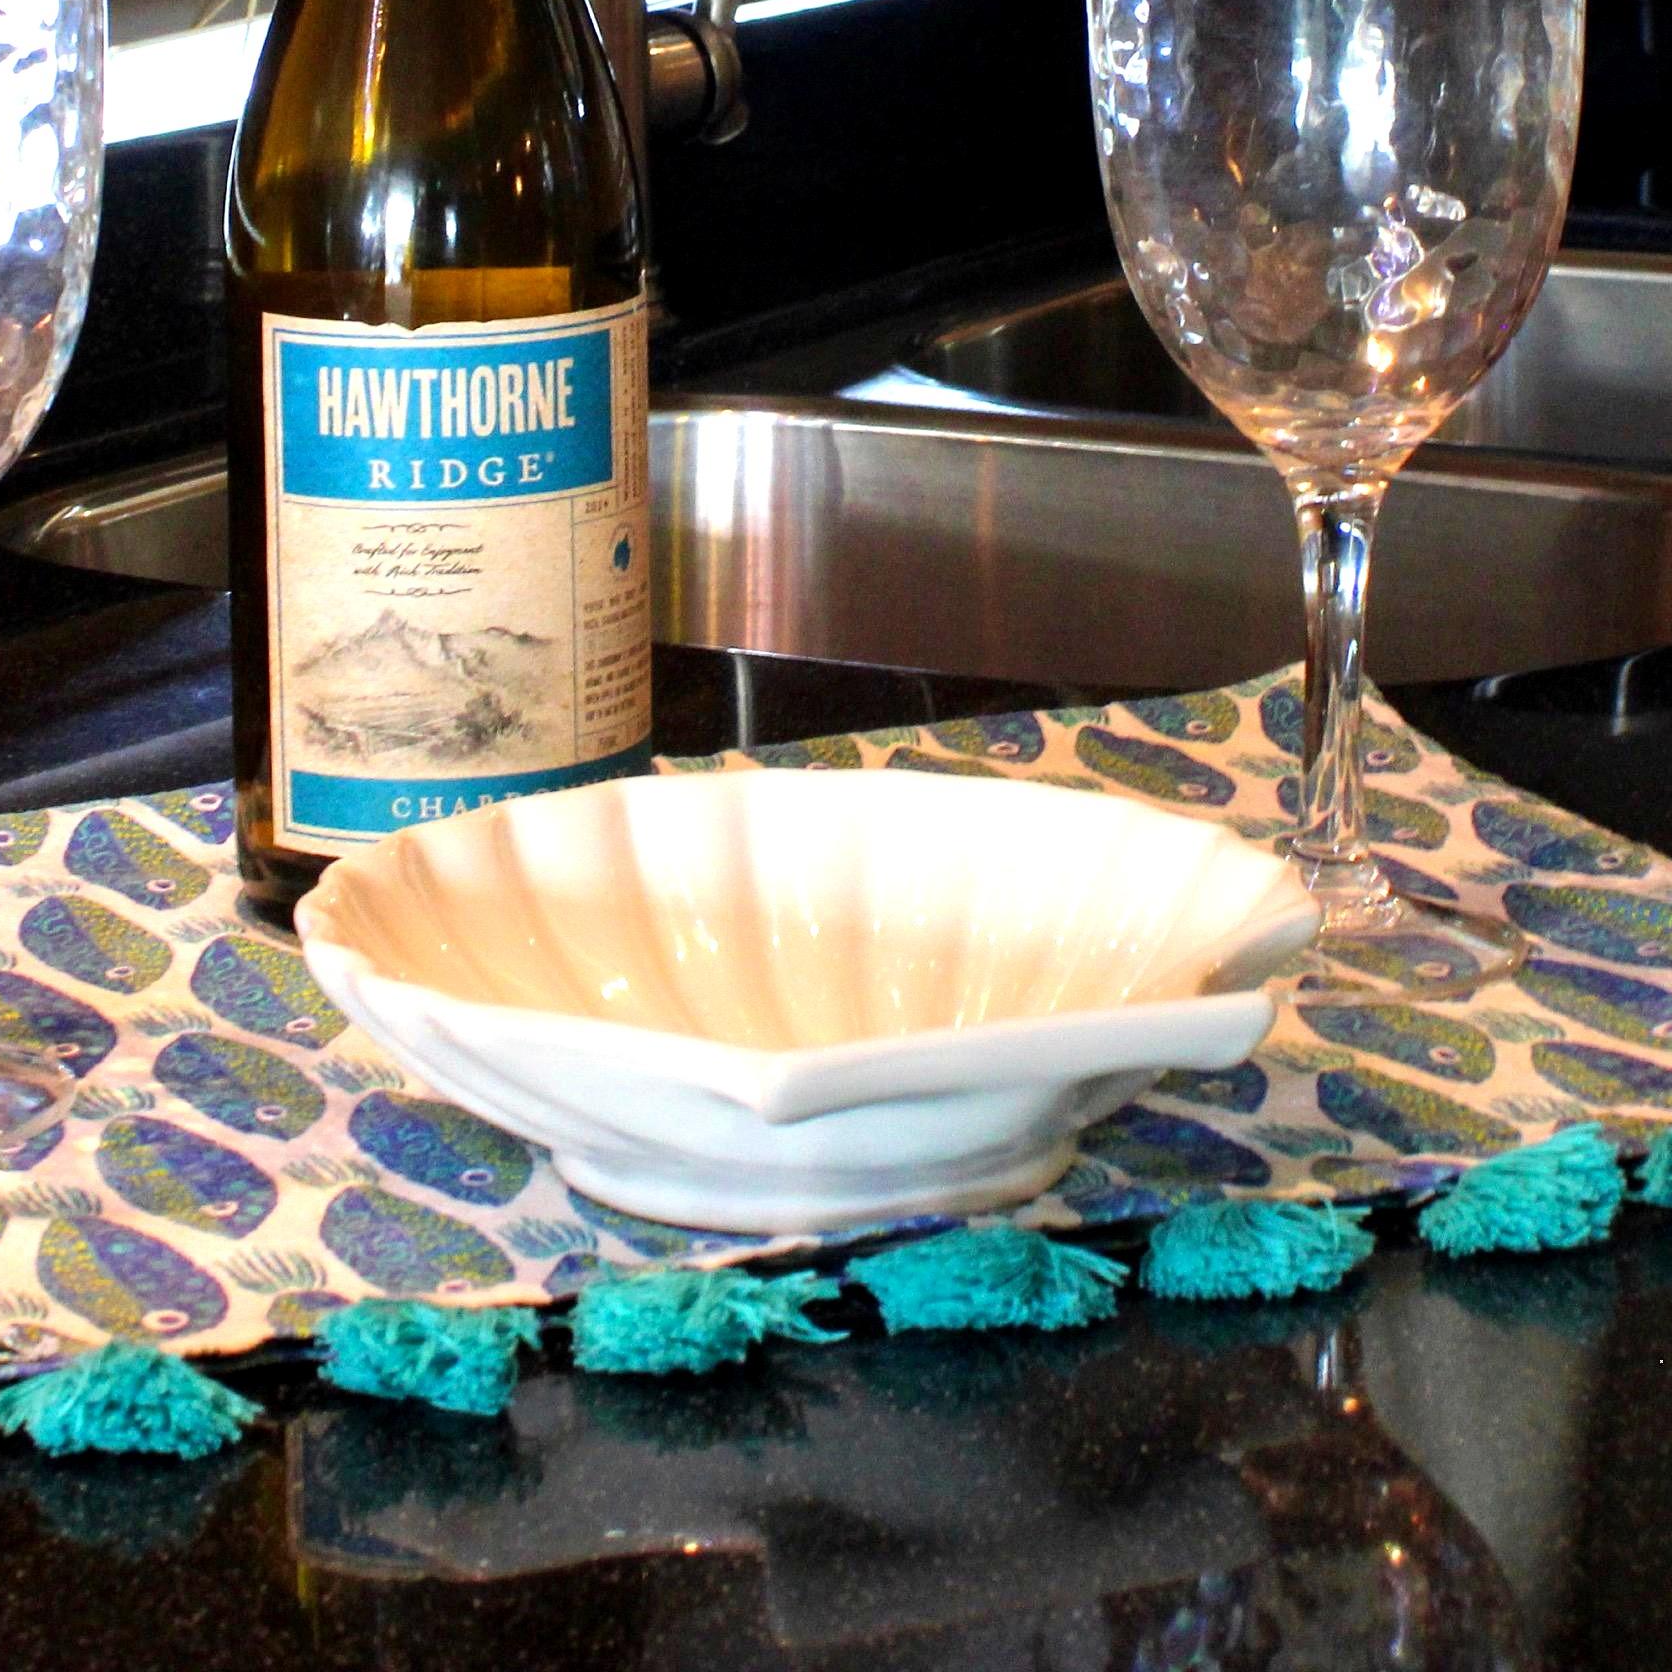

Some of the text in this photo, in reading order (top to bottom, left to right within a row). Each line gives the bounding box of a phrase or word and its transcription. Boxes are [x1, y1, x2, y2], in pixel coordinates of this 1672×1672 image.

[318, 357, 576, 439] HAWTHORNE
[368, 453, 544, 489] RIDGE
[352, 542, 484, 561] Crafted for Enjoyment
[423, 561, 483, 576] Tradition
